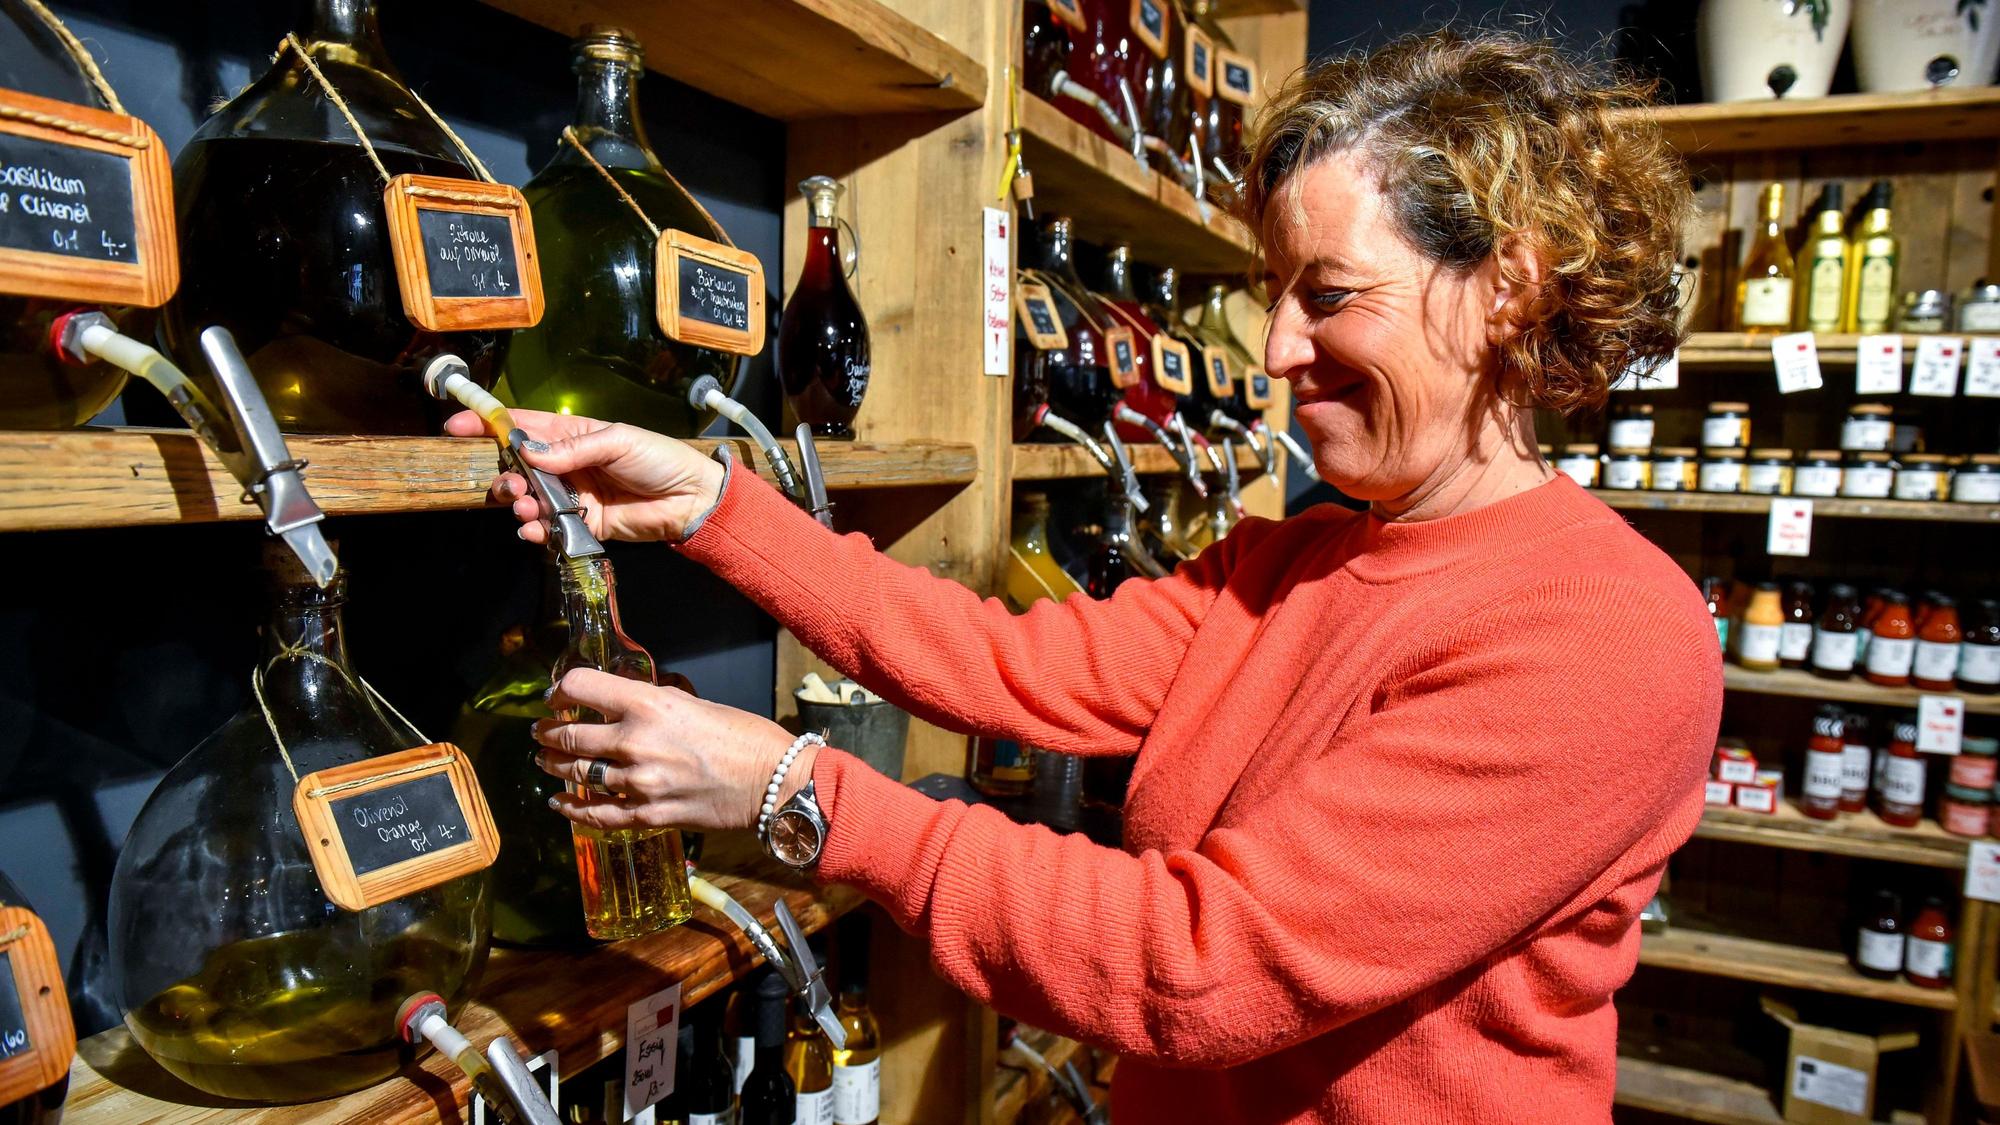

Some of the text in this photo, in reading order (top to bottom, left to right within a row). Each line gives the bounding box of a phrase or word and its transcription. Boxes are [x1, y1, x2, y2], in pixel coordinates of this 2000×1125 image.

[19, 194, 92, 223] Olivenöl
[440, 246, 461, 272] auf
[353, 794, 408, 829] Olivenöl
[638, 1036, 665, 1066] Essig
